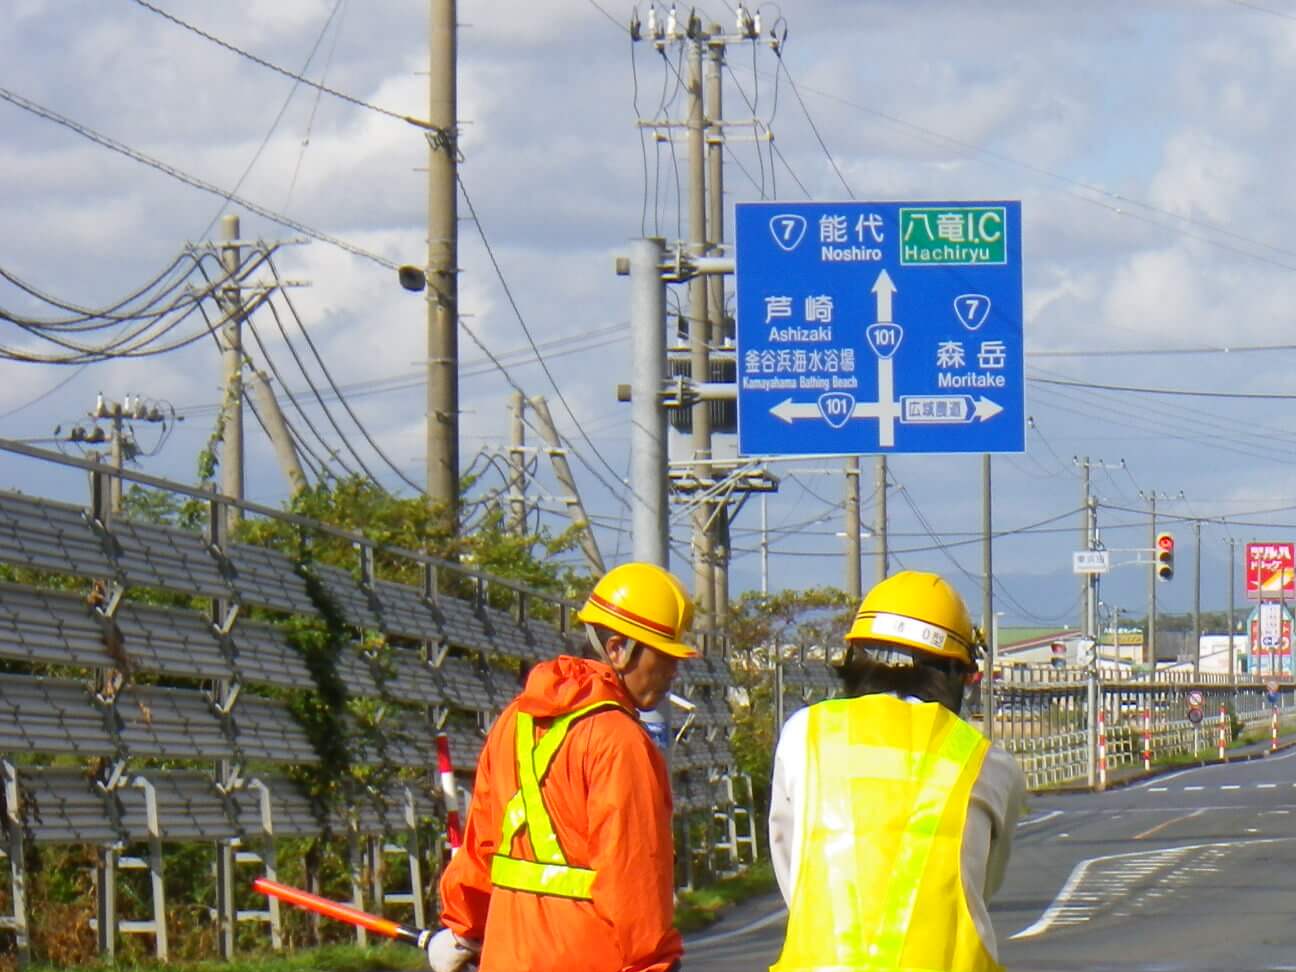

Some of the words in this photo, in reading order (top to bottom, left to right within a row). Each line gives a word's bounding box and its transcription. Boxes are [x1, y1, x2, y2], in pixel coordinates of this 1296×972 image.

[781, 220, 793, 240] 7
[819, 214, 884, 243] 能代
[822, 246, 882, 262] Noshiro
[904, 245, 990, 263] Hachiryu
[965, 300, 979, 319] 7
[769, 326, 832, 342] Ashizaki
[874, 330, 895, 345] 101
[745, 348, 855, 373] 釜谷浜海水浴場
[937, 341, 1006, 369] 森岳
[800, 376, 830, 391] Bathing
[832, 375, 858, 389] Beach
[938, 372, 1005, 388] Moritake
[825, 399, 847, 414] 101
